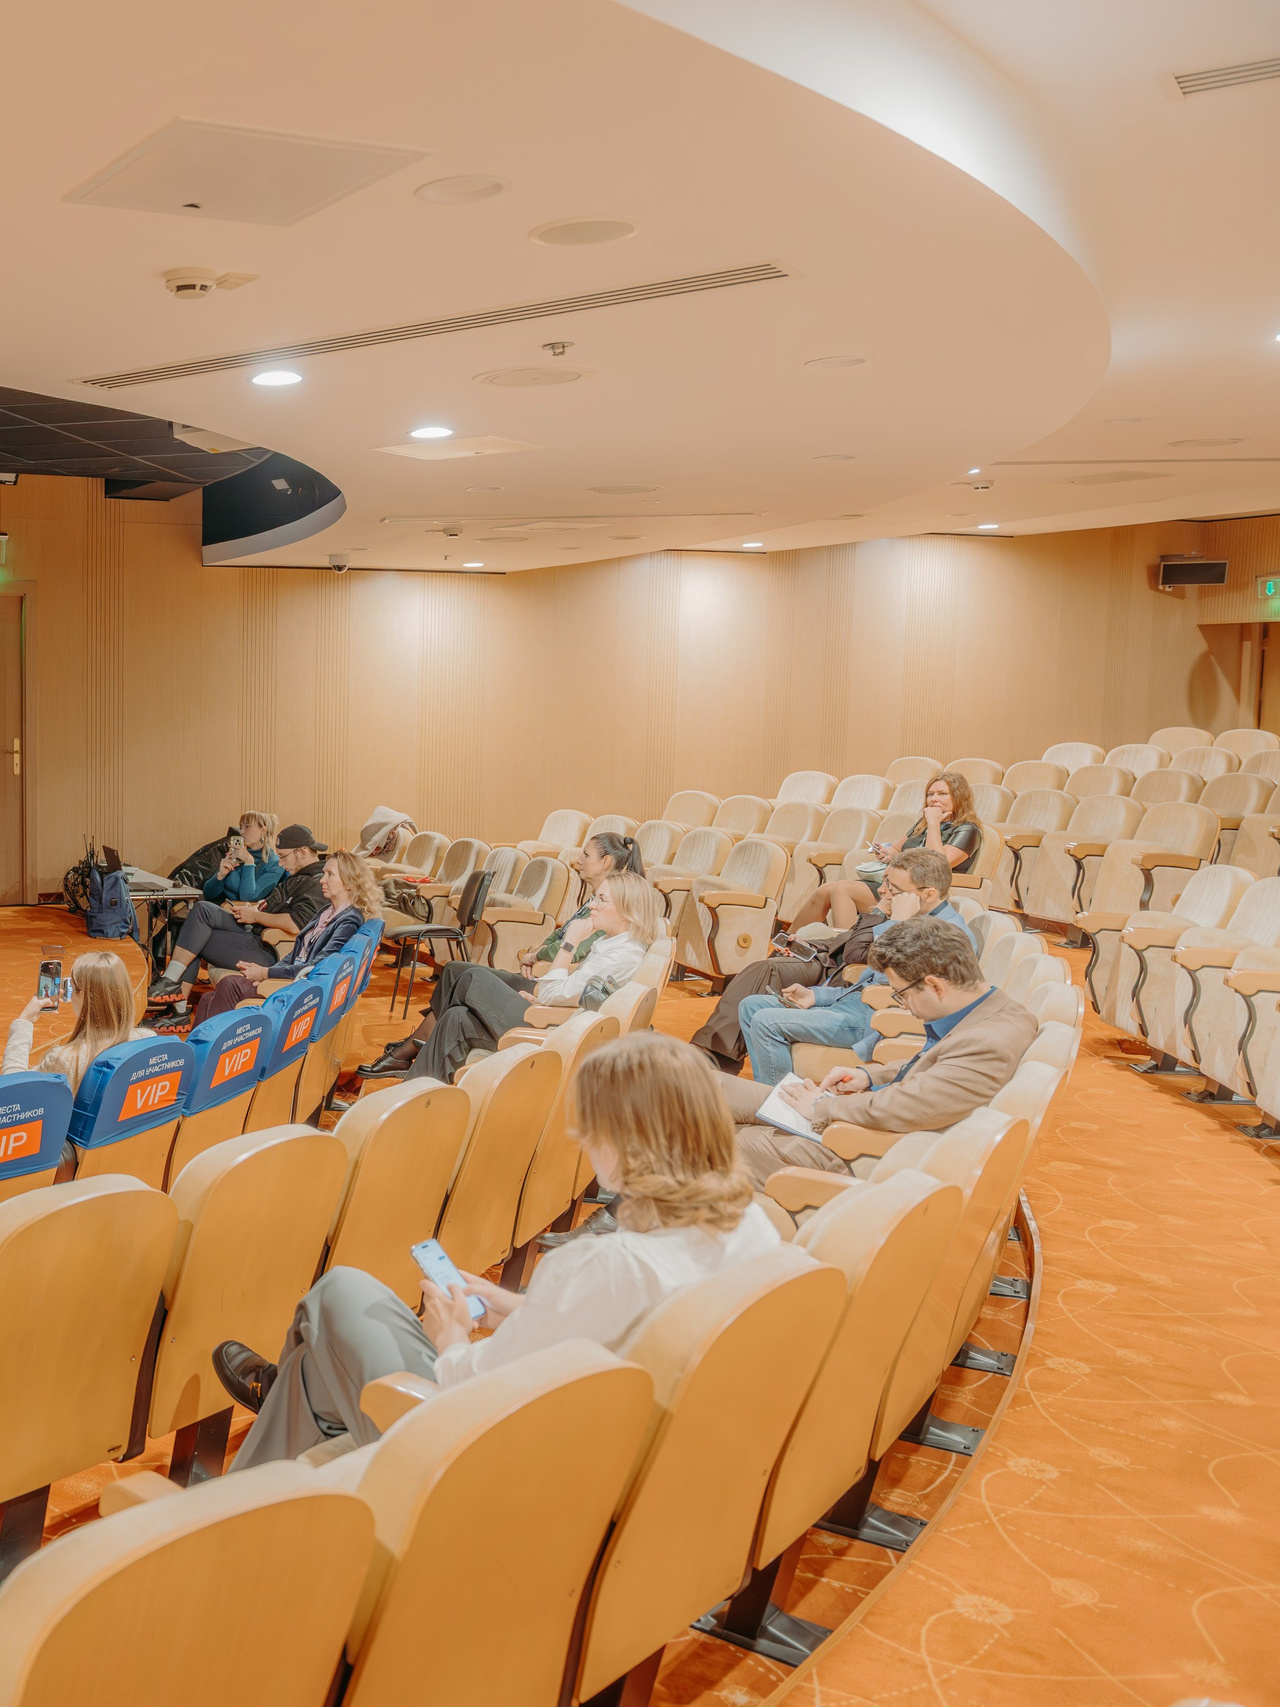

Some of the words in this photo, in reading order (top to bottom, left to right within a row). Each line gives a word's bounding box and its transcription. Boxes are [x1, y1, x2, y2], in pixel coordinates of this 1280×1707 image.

[233, 1026, 262, 1045] УЧАСТНИКОВ
[236, 1023, 250, 1035] МЕСТА
[292, 1016, 310, 1042] VIP
[130, 1068, 144, 1082] ДЛЯ
[146, 1058, 184, 1076] УЧАСТНИКОВ
[149, 1053, 168, 1066] МЕСТА
[224, 1048, 251, 1076] VIP
[137, 1081, 170, 1110] VIP
